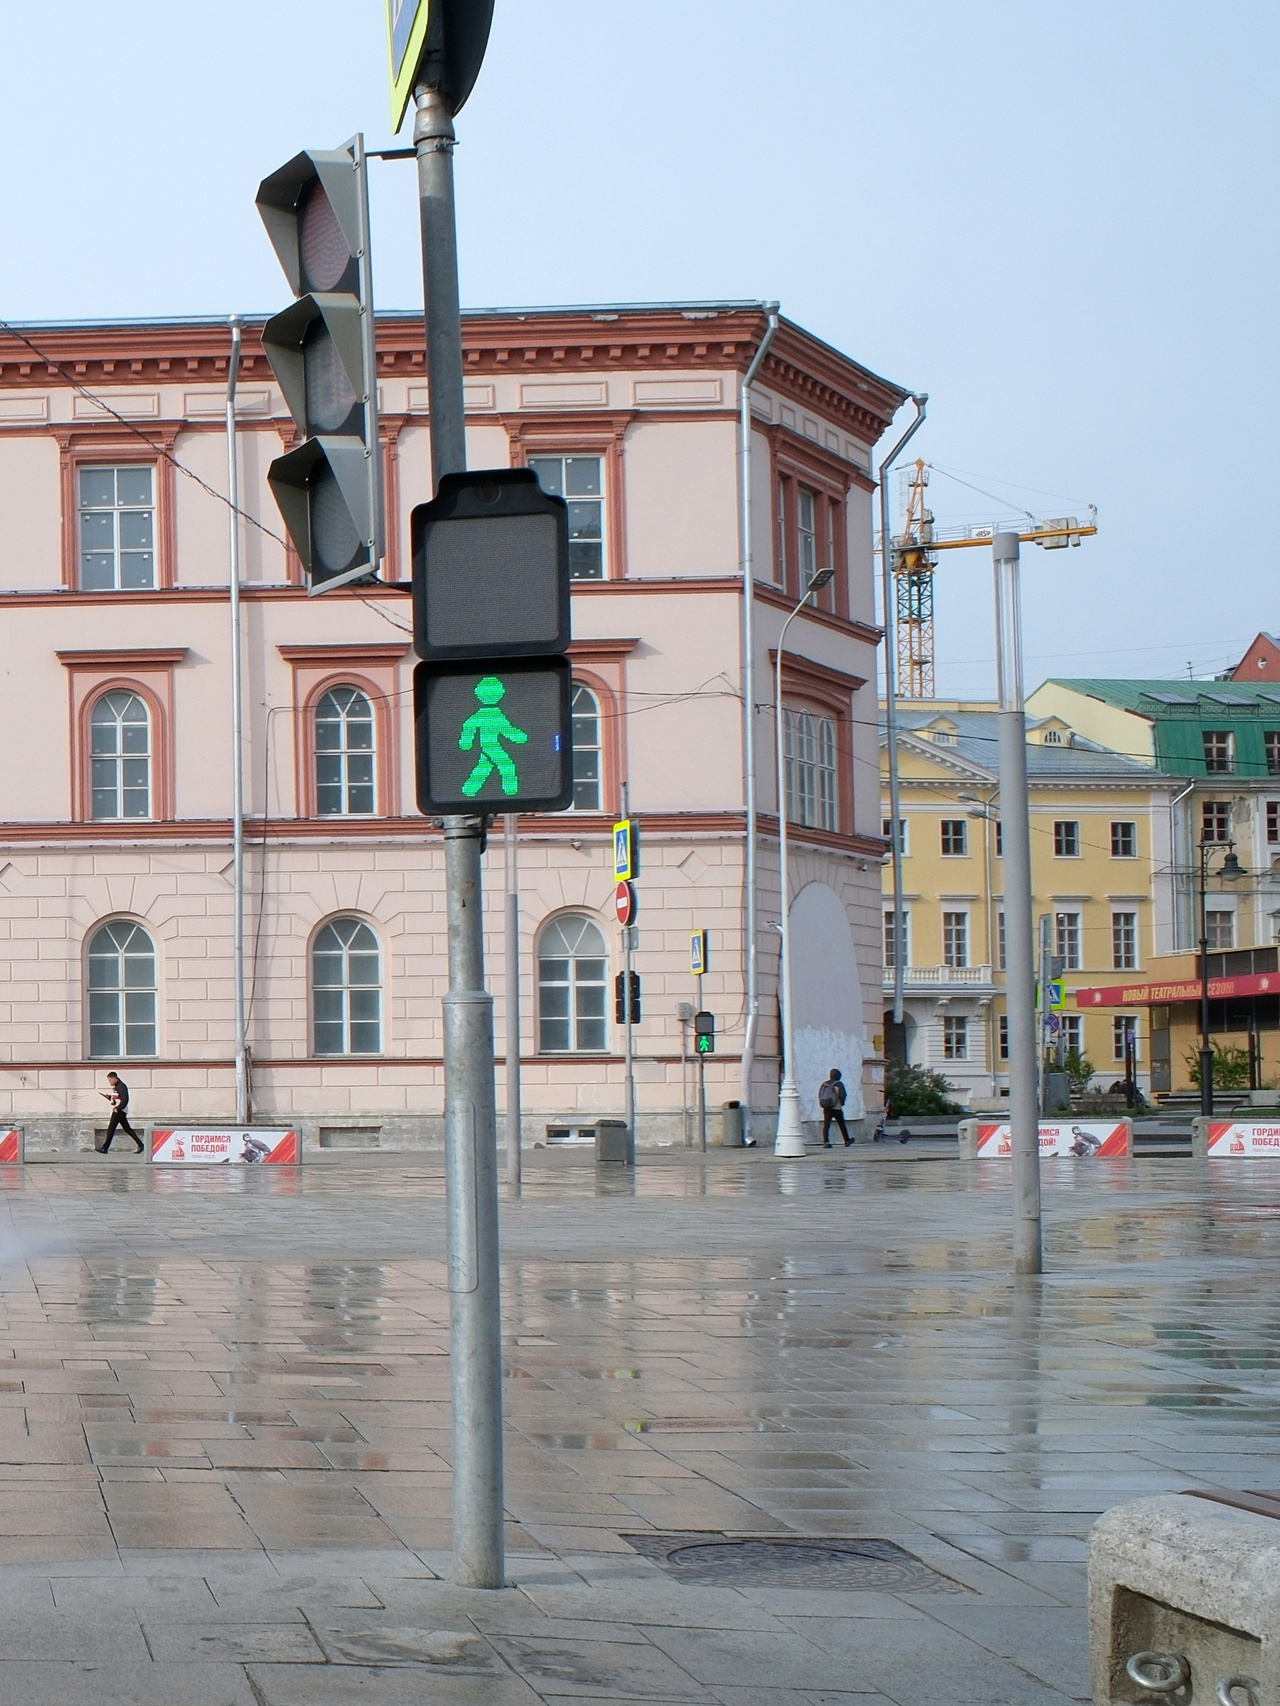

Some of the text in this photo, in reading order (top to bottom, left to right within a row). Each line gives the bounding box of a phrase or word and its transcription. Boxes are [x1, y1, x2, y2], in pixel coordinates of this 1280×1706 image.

[1122, 986, 1149, 1002] НОВЫЙ
[1207, 981, 1235, 998] СЕЗОН!
[1252, 1128, 1280, 1137] ГОРДИ
[191, 1134, 231, 1143] ГОРДИМСЯ
[1252, 1138, 1280, 1147] ПОБЕД
[191, 1143, 227, 1153] ПОБЕДОЙ!
